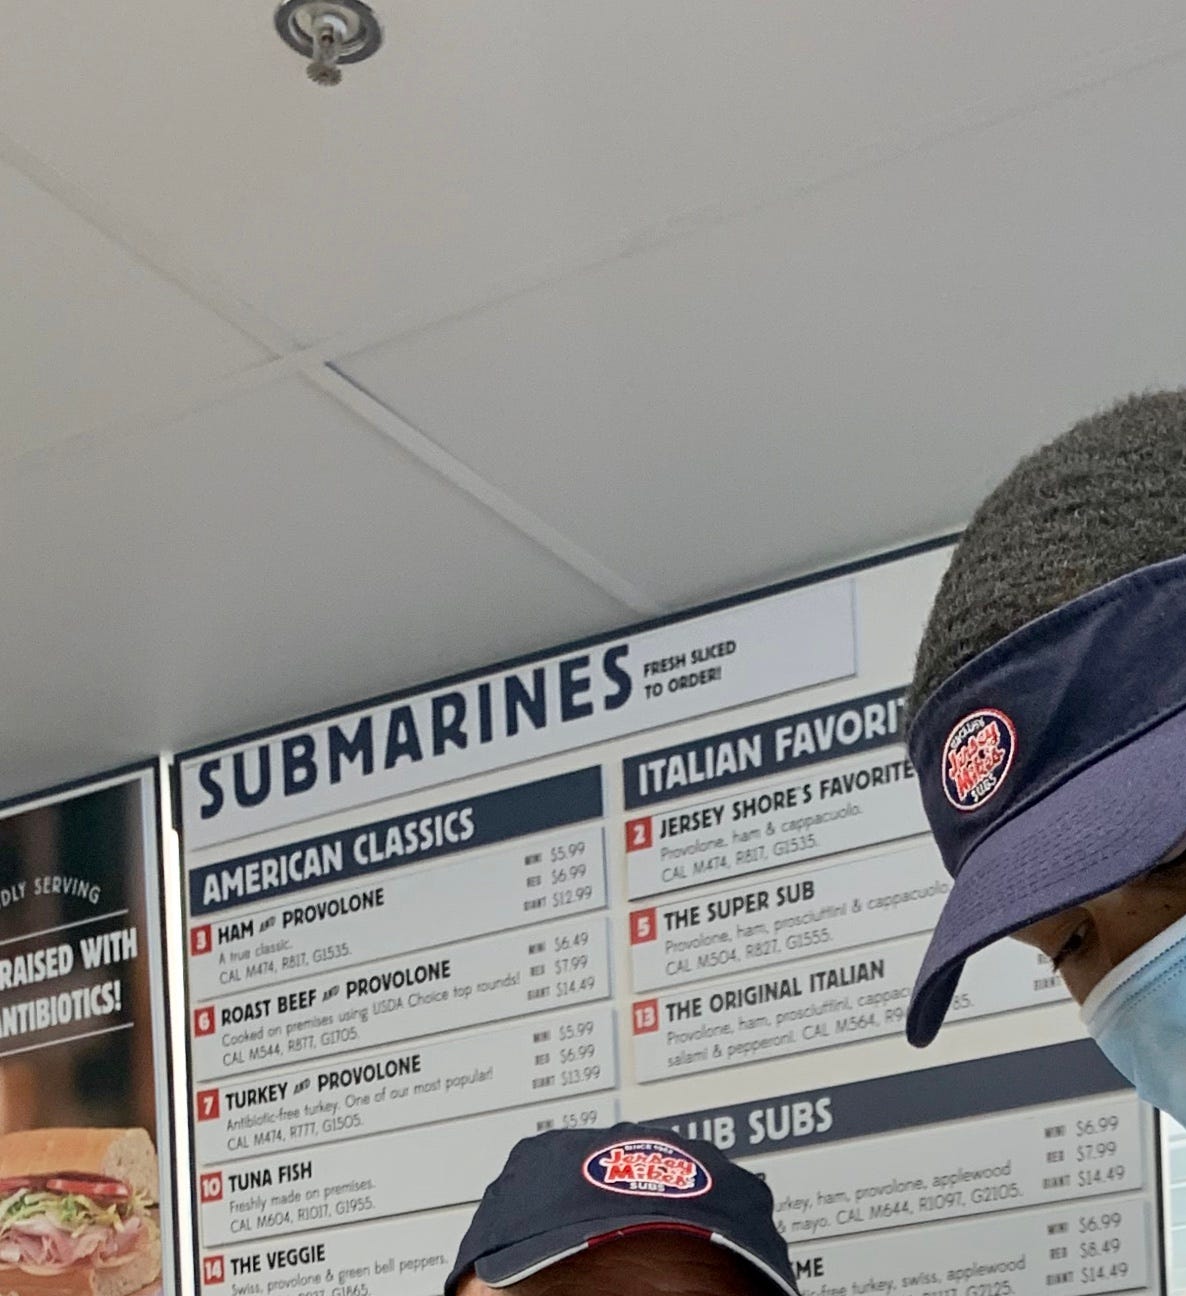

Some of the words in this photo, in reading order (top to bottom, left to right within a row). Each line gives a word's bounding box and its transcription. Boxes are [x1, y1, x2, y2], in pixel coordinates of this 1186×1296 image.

[644, 654, 686, 677] FRESH
[691, 640, 736, 664] SLICED
[644, 682, 662, 698] TO
[668, 666, 721, 692] ORDER!
[200, 643, 632, 819] SUBMARINES
[639, 734, 761, 795] ITALIAN
[776, 698, 901, 761] FAVORI
[660, 805, 724, 838] JERSEY
[732, 783, 812, 821] SHORE'S
[820, 758, 911, 799] FAVORITE
[203, 841, 342, 905] AMERICAN
[354, 807, 474, 864] CLASSICS
[551, 842, 585, 861] $5.99
[551, 865, 586, 884] $6.99
[34, 876, 101, 904] SERVING
[552, 886, 592, 909] $12.99
[218, 920, 253, 944] HAM
[282, 887, 384, 928] PROVOLONE
[663, 906, 700, 930] THE
[707, 891, 768, 922] SUPER
[776, 881, 814, 906] SUB
[554, 932, 588, 951] $6.49
[0, 943, 74, 990] RAISED
[80, 927, 138, 969] WITH
[555, 956, 587, 975] $7.99
[222, 999, 270, 1026] ROAST
[277, 989, 316, 1013] BEEF
[346, 960, 450, 999] PROVOLONE
[556, 976, 595, 999] $14.49
[665, 997, 702, 1022] THE
[710, 977, 802, 1012] ORIGINAL
[810, 959, 884, 992] ITALIAN
[559, 1021, 594, 1041] $5.99
[560, 1044, 595, 1064] $6.99
[225, 1082, 288, 1110] TURKEY
[318, 1054, 420, 1092] PROVOLONE
[561, 1064, 600, 1087] $13.99
[748, 1098, 833, 1144] SUBS
[1076, 1116, 1118, 1137] $6.99
[1077, 1141, 1117, 1162] $7.99
[228, 1169, 272, 1192] TUNA
[278, 1161, 311, 1183] FISH
[630, 1181, 665, 1192] SUBS
[1077, 1166, 1125, 1188] $14.49
[1079, 1212, 1122, 1233] $6.99
[230, 1254, 261, 1275] THE
[266, 1244, 325, 1269] VEGGIE
[1080, 1238, 1121, 1260] $8.49
[232, 1283, 263, 1296] Swiss,
[267, 1273, 321, 1294] provolone
[325, 1268, 334, 1282] &
[338, 1266, 370, 1285] green
[374, 1258, 394, 1274] bell
[399, 1255, 448, 1274] peppers.
[1081, 1262, 1129, 1285] $14.49
